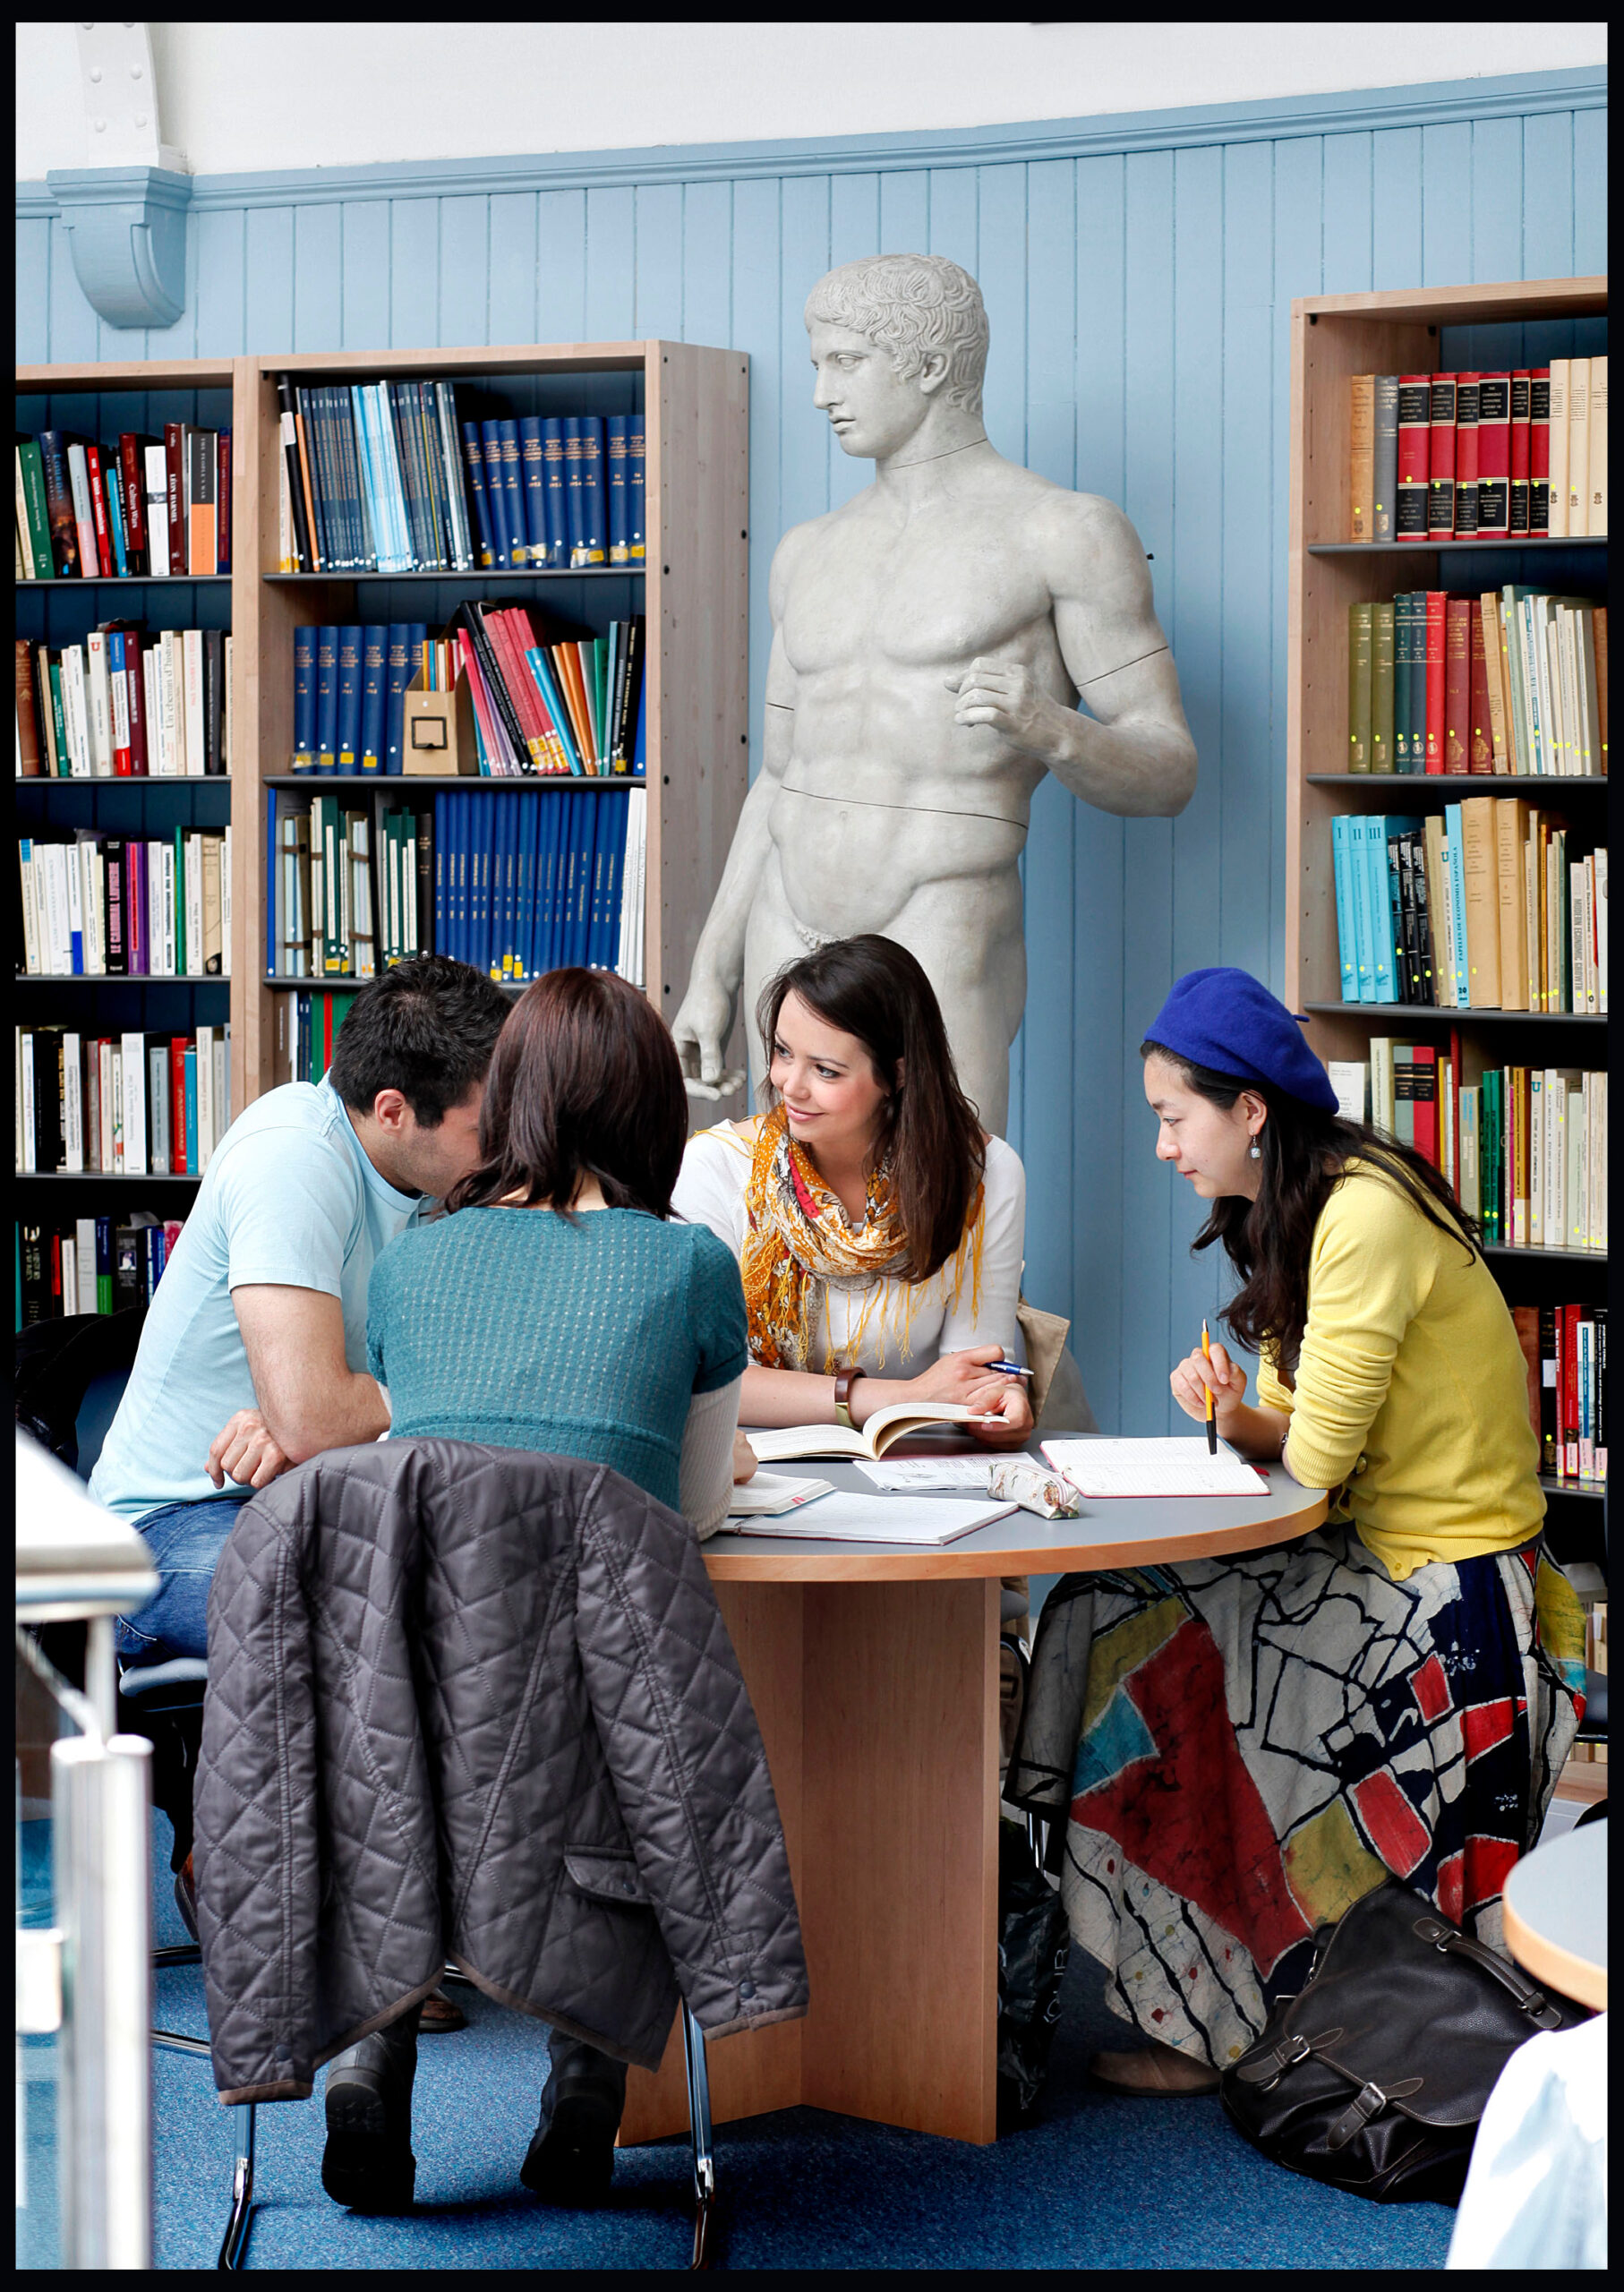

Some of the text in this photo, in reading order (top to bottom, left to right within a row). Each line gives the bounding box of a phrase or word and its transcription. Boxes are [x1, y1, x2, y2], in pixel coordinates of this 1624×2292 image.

[129, 483, 138, 509] Culture
[162, 634, 175, 729] Un chemin d'histoire
[1451, 846, 1459, 882] ESPAÑOLA
[1453, 883, 1462, 920] ECONOMIA
[1456, 931, 1464, 961] PAPELES
[1574, 899, 1584, 990] MODERN ECONOMIC GROWTH
